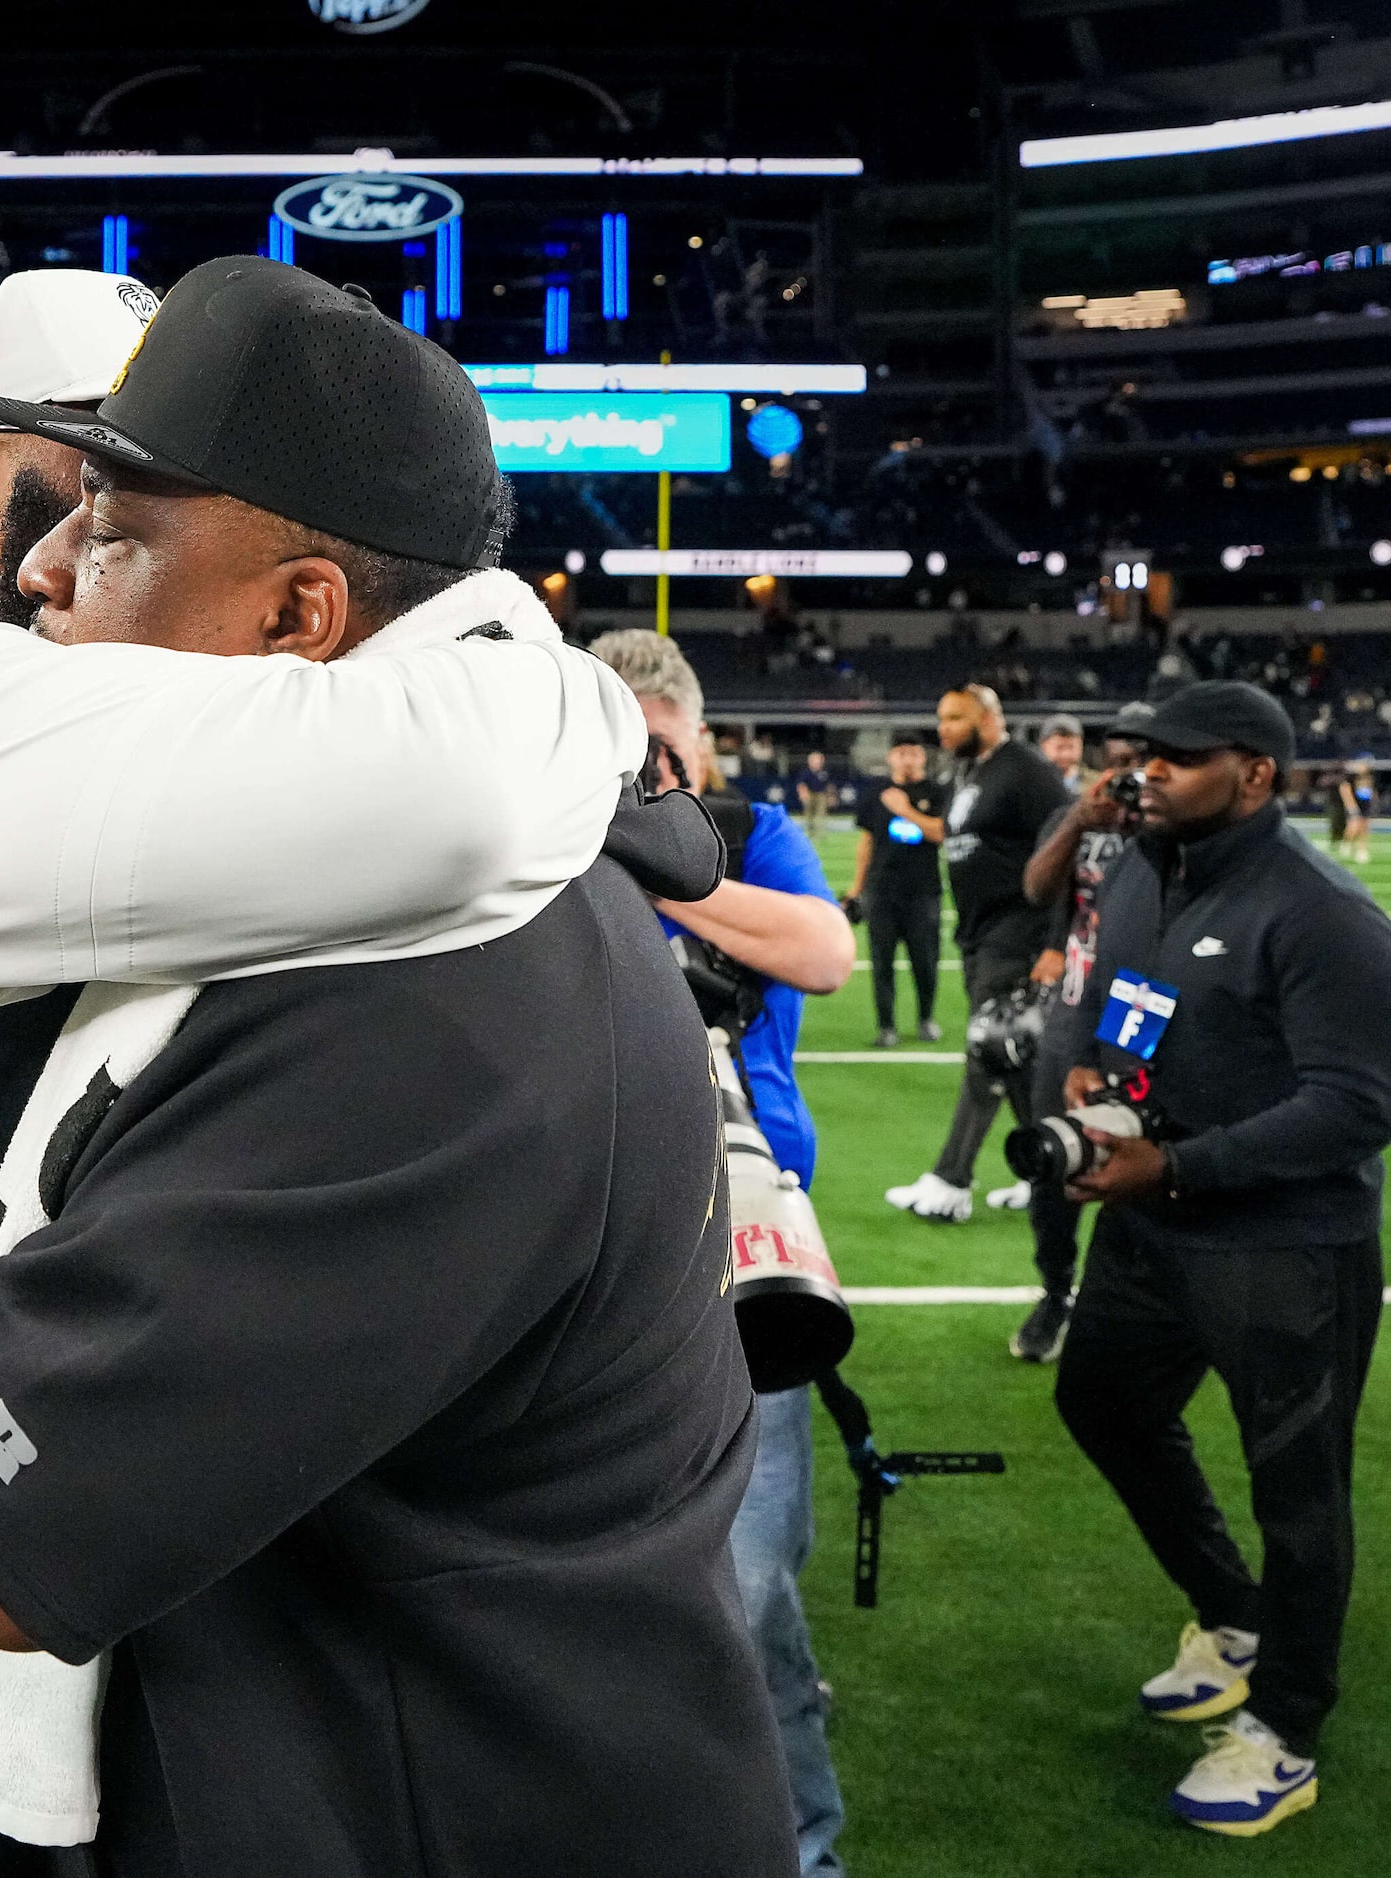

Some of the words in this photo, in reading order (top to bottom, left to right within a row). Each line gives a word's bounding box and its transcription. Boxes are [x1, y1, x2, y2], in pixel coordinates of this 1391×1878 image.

[309, 181, 429, 230] Ford
[486, 411, 664, 456] verything
[1116, 1009, 1146, 1048] F
